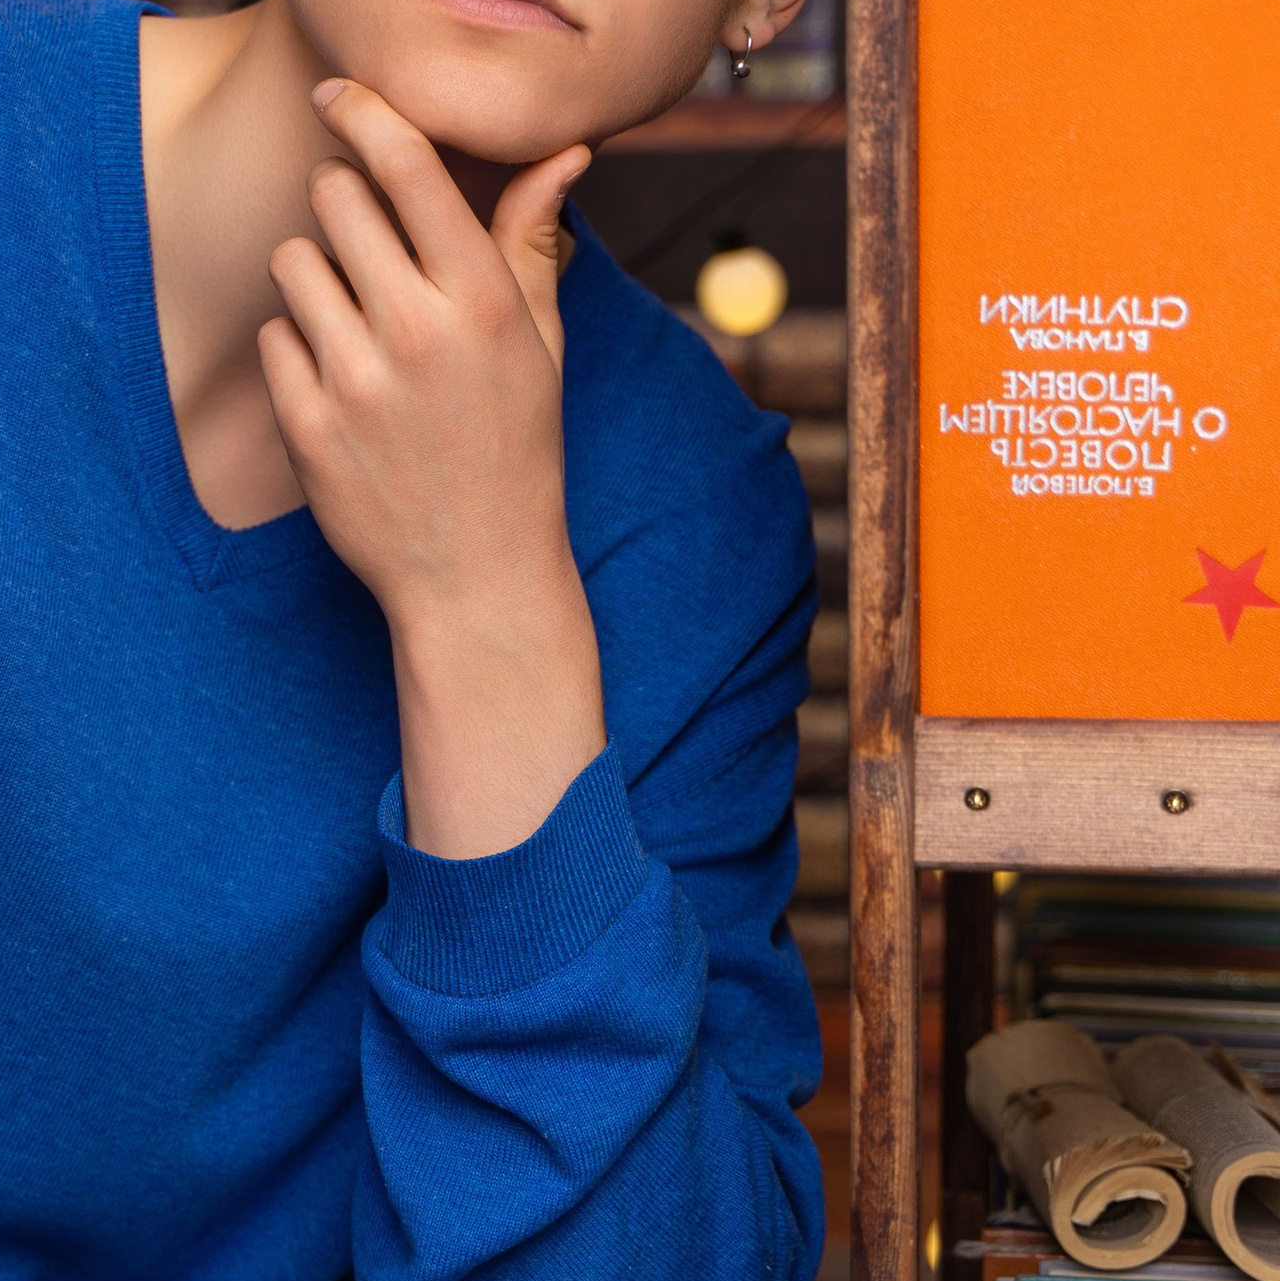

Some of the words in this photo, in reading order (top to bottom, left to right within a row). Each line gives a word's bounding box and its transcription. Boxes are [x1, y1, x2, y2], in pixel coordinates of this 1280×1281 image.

[979, 294, 1190, 329] СПУТНИКИ
[1001, 370, 1175, 404] ЧЕЛОВЕКЕ
[939, 399, 1183, 438] НАСТОЯЩЕМ
[1192, 406, 1229, 441] О
[990, 437, 1174, 472] ПОВЕСТЬ
